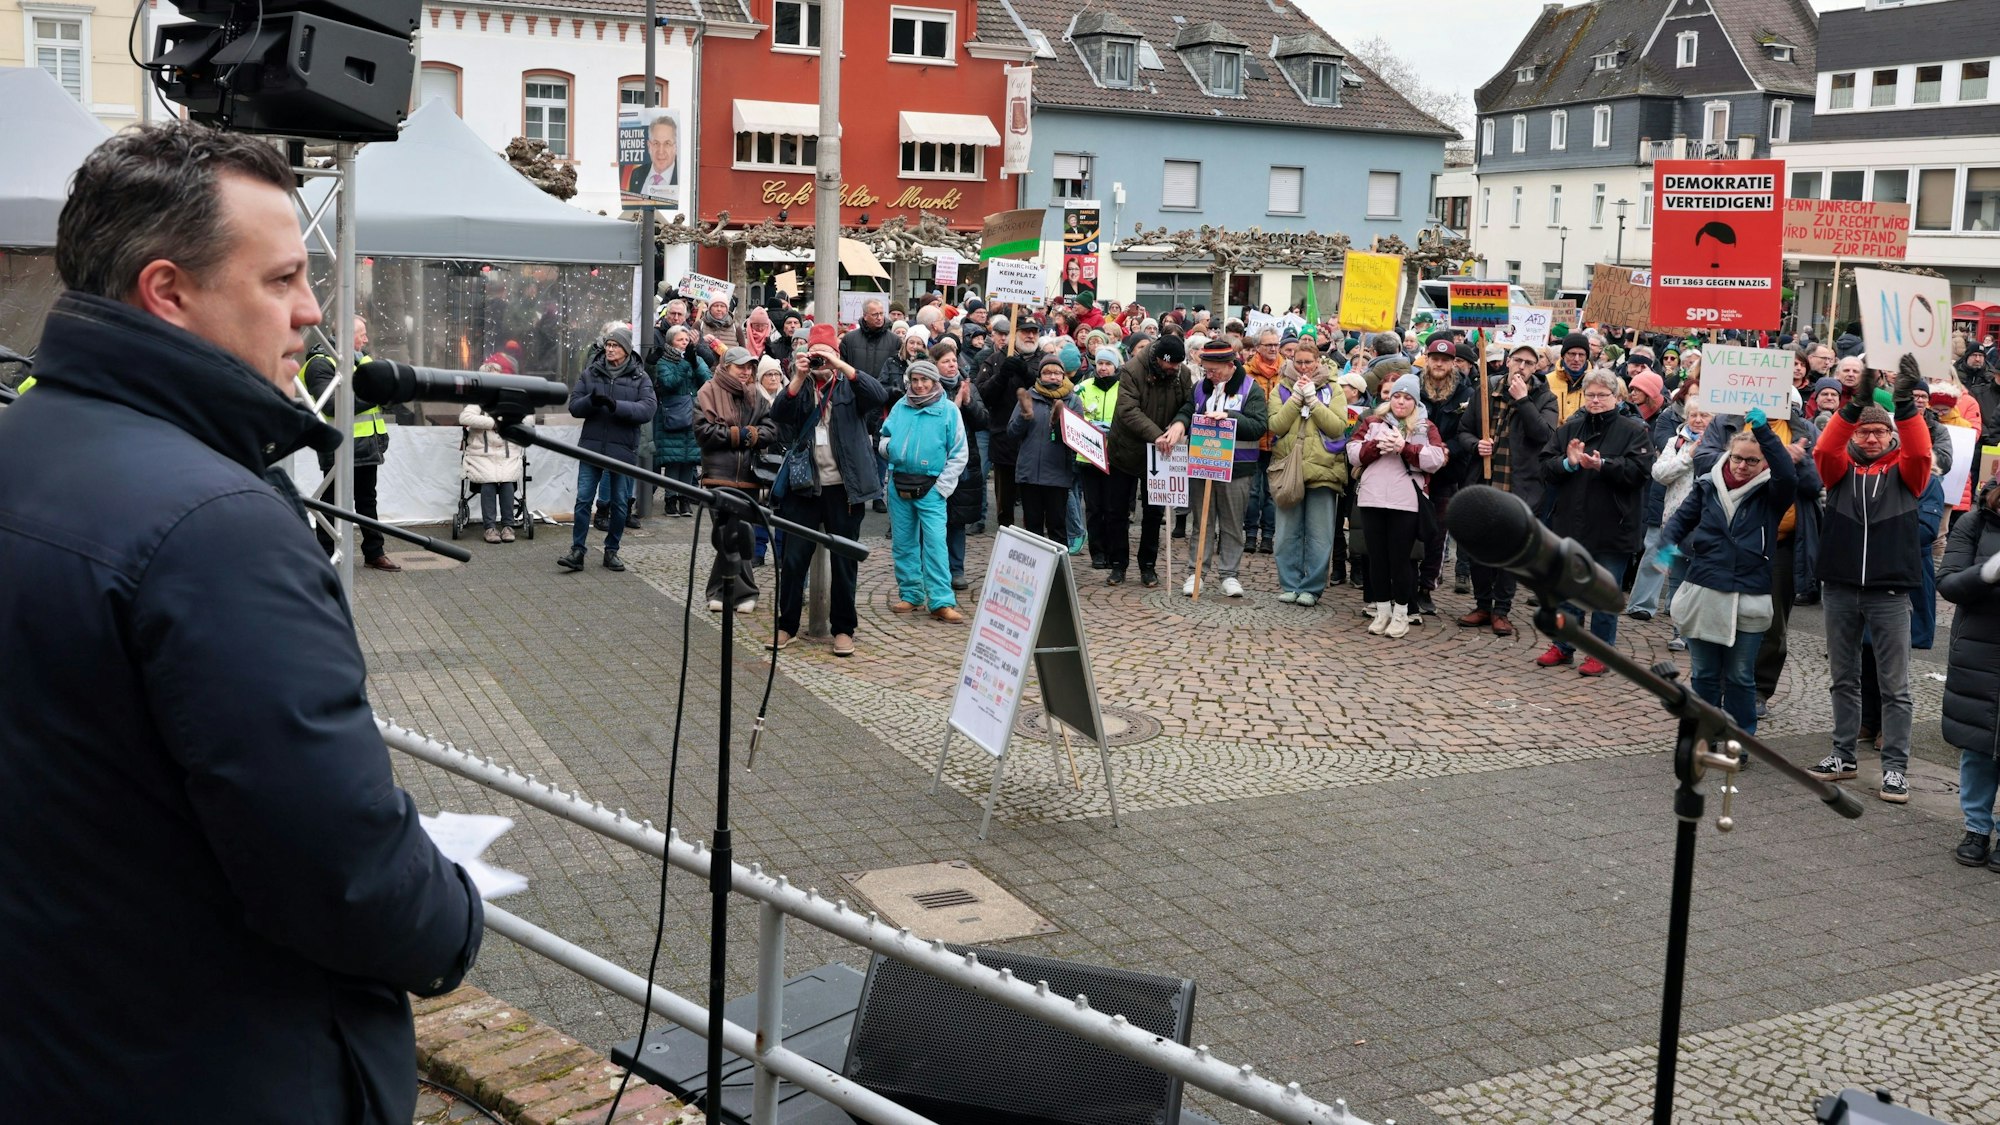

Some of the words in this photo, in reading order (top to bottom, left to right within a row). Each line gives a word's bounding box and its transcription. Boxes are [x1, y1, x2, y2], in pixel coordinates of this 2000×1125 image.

[620, 129, 645, 138] POLITIK
[620, 139, 646, 149] WENDE
[619, 150, 644, 162] JETZT
[1665, 176, 1772, 190] DEMOKRATIE
[761, 180, 814, 209] Café
[886, 185, 963, 210] Markt
[1665, 196, 1772, 209] VERTEIDIGEN!
[1817, 201, 1876, 214] UNRECHT
[1813, 213, 1834, 227] ZU
[1840, 215, 1880, 229] RECHT
[1814, 228, 1897, 244] WIDERSTAND
[1832, 242, 1859, 255] ZUR
[997, 261, 1040, 272] EUSKIRCHEN,
[1596, 267, 1631, 283] WENN
[1682, 278, 1704, 286] 1863
[1706, 279, 1736, 287] GEGEN
[1738, 279, 1769, 287] NAZIS.
[996, 287, 1036, 296] INTOLERANZ
[1455, 288, 1503, 297] VIELFALT
[1462, 302, 1496, 310] STATT
[1591, 294, 1618, 310] WIE
[1458, 315, 1502, 325] EINFALT
[1585, 307, 1614, 324] DANN
[1686, 307, 1719, 321] SPD
[1707, 350, 1793, 368] VIELFALT
[1727, 373, 1778, 388] STATT
[1066, 424, 1081, 438] KEIN
[1219, 420, 1234, 430] SO,
[1191, 427, 1217, 438] DASS
[1219, 431, 1234, 439] DIE
[1066, 431, 1104, 463] RASSISMUS
[1201, 447, 1222, 457] WAS
[1172, 455, 1188, 463] NICHTS
[1189, 456, 1231, 469] DAGEGEN
[1192, 468, 1226, 480] HÄTTE!
[1149, 478, 1166, 490] ABER
[1169, 476, 1185, 492] DU
[1149, 492, 1176, 504] KANNST
[1178, 493, 1188, 505] ES!
[1008, 549, 1037, 569] GEMEINSAM
